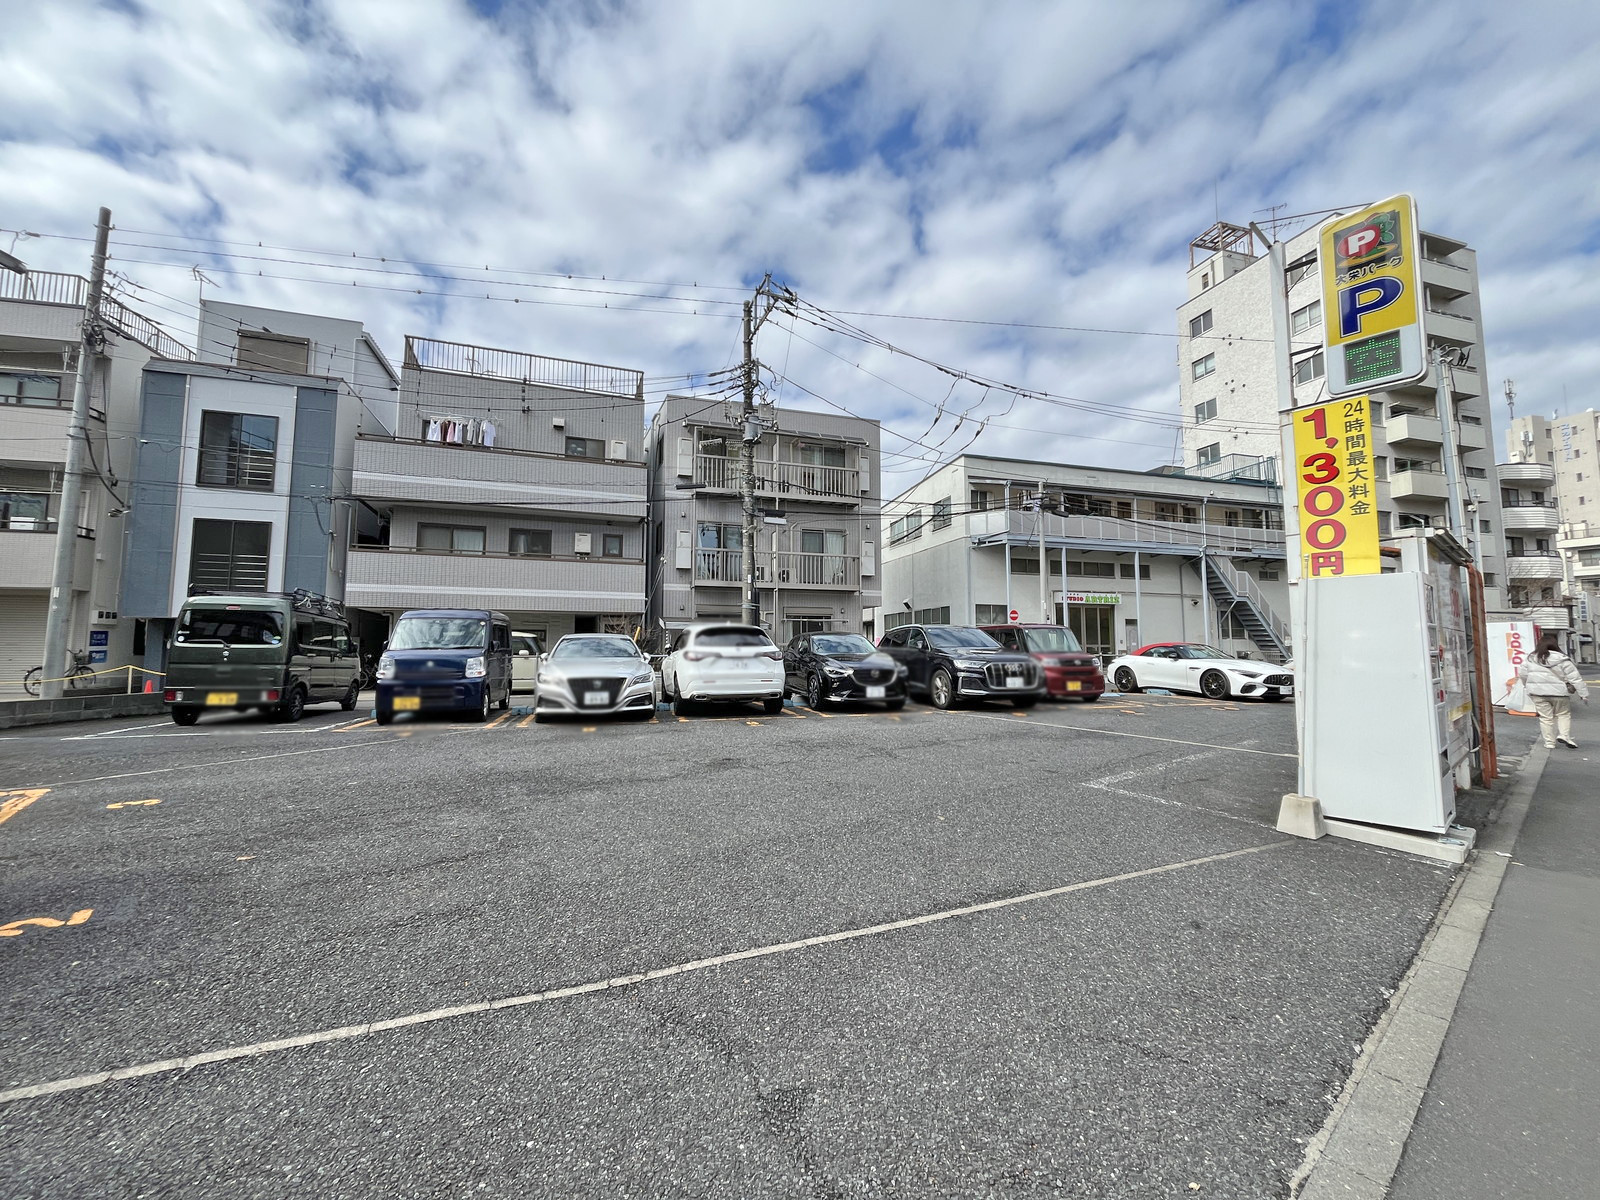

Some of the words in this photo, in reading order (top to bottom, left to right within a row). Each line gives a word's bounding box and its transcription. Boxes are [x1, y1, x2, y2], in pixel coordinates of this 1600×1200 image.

[1348, 229, 1376, 255] P
[1336, 256, 1403, 286] 大栄パーク
[1338, 276, 1405, 338] P
[1346, 338, 1402, 384] 空
[1343, 400, 1371, 516] 24時間最大料金
[1303, 408, 1346, 576] 1,300円
[1510, 632, 1526, 665] DyDo
